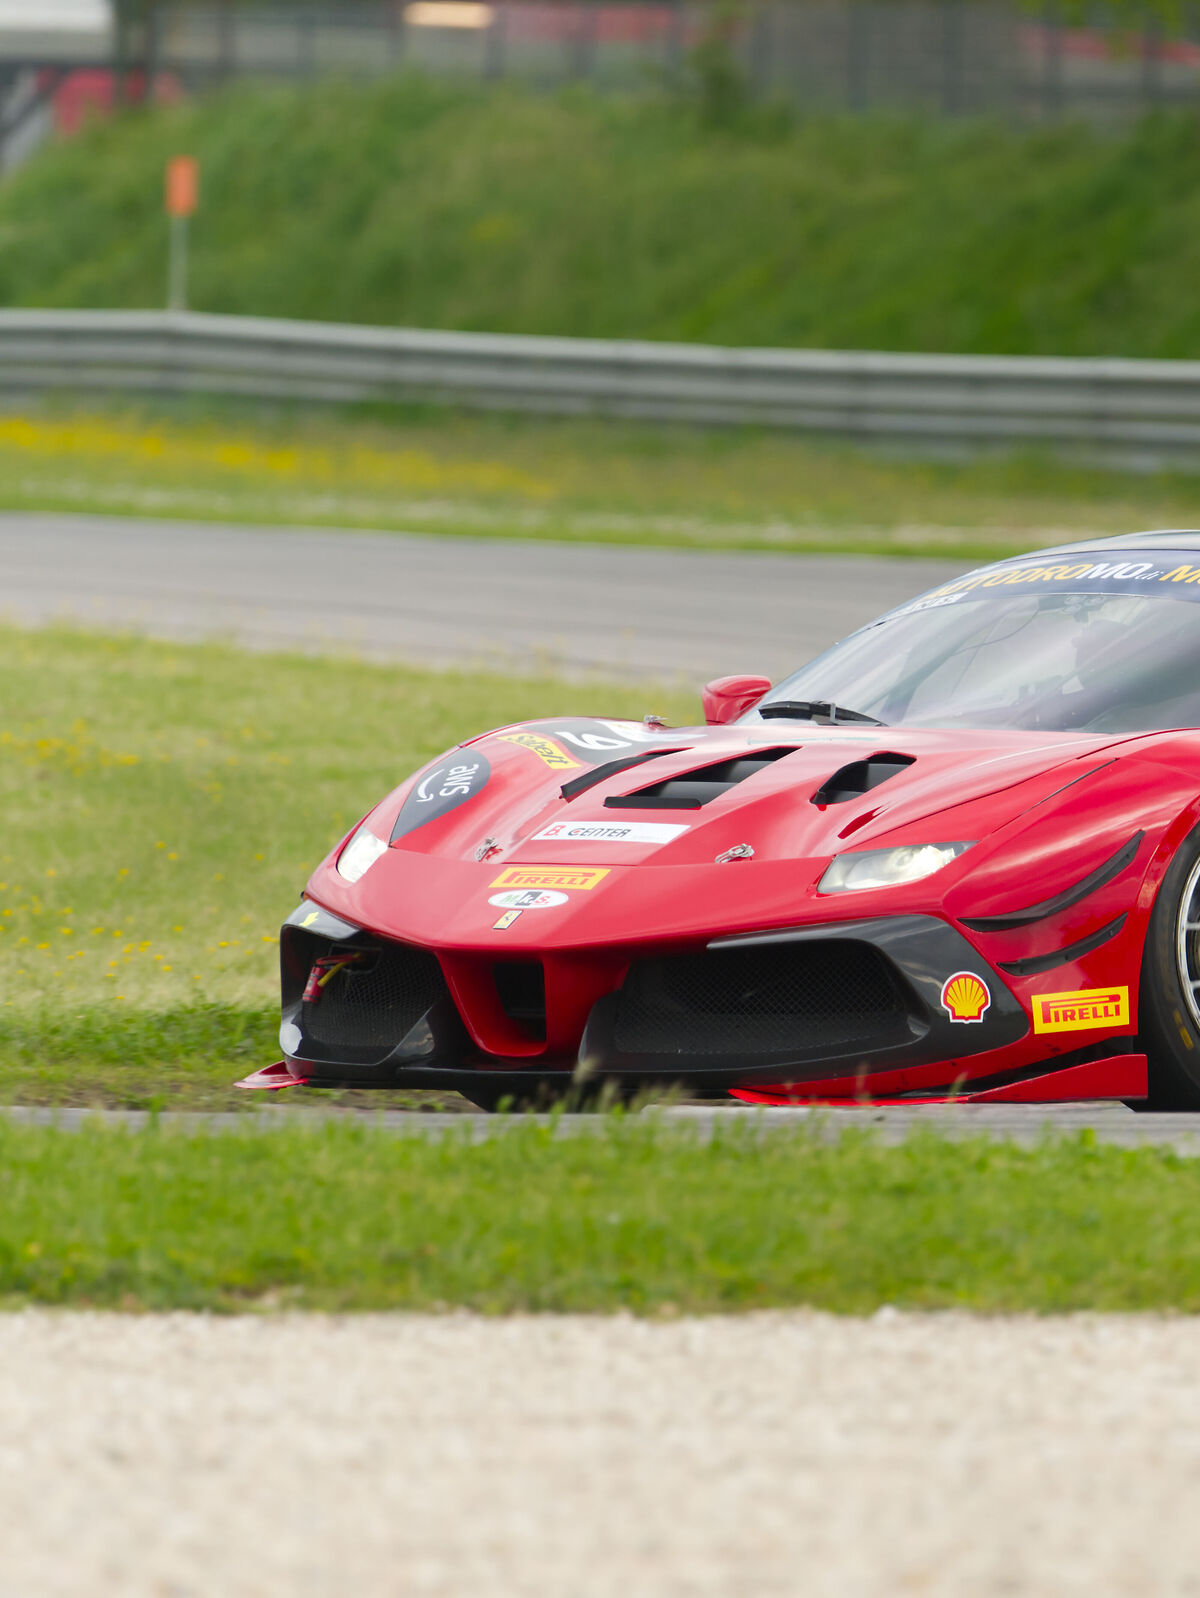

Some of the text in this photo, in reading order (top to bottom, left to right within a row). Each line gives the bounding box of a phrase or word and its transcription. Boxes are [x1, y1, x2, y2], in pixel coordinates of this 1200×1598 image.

[439, 763, 479, 797] aws
[568, 828, 632, 838] CENTER
[504, 872, 596, 885] PIRELLI
[1041, 994, 1121, 1024] PIRELLI
